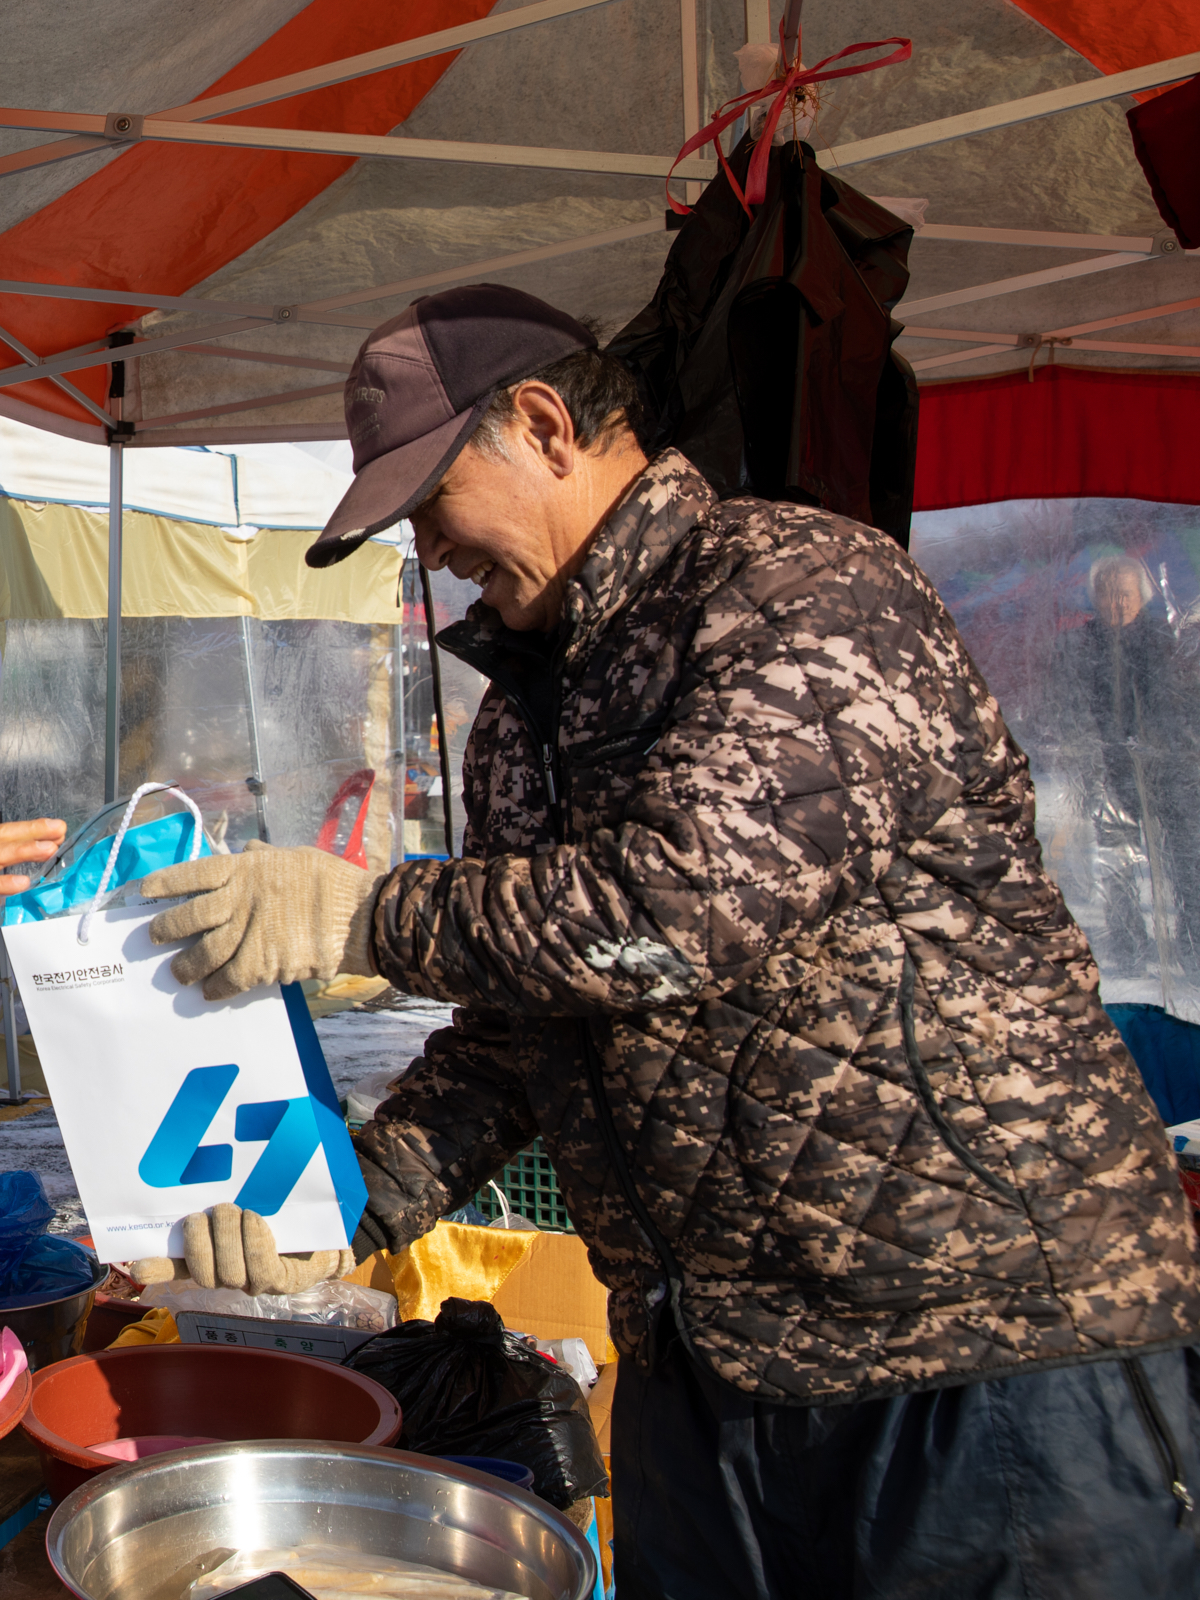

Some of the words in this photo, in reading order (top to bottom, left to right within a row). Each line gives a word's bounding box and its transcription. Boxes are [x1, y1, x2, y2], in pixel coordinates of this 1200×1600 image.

[32, 963, 123, 985] 한국전기안전공사
[51, 983, 74, 991] Electrical
[75, 981, 91, 989] Safety
[92, 977, 125, 986] Corporation
